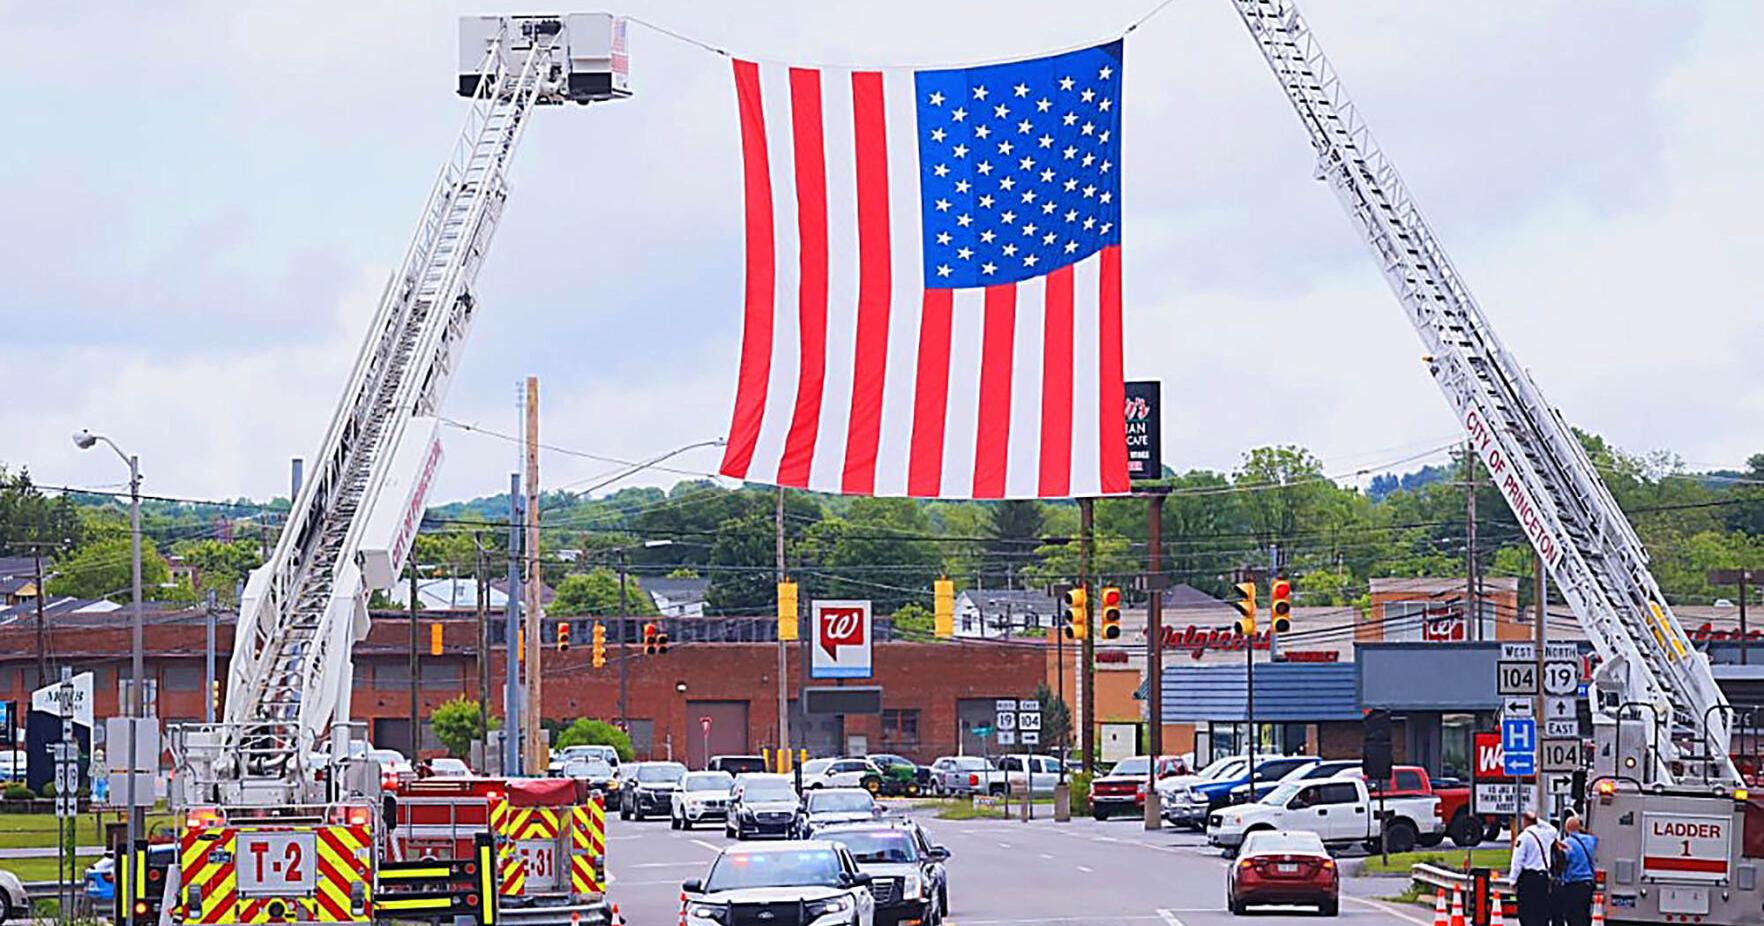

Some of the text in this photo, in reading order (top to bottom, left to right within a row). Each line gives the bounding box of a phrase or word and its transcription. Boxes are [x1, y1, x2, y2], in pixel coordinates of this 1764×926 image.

[1467, 412, 1558, 565] CITY OF PRINCETON
[824, 612, 858, 638] W
[1504, 647, 1531, 657] WEST
[1545, 647, 1576, 658] NORTH
[1503, 669, 1533, 688] 104
[1550, 669, 1571, 688] 19
[1000, 714, 1012, 726] 19
[1021, 715, 1039, 727] 104
[1509, 724, 1529, 748] H
[1550, 724, 1574, 734] EAST
[1547, 746, 1576, 765] 104
[1654, 822, 1720, 838] LADDER
[1681, 840, 1692, 856] 1
[251, 842, 302, 882] T-2
